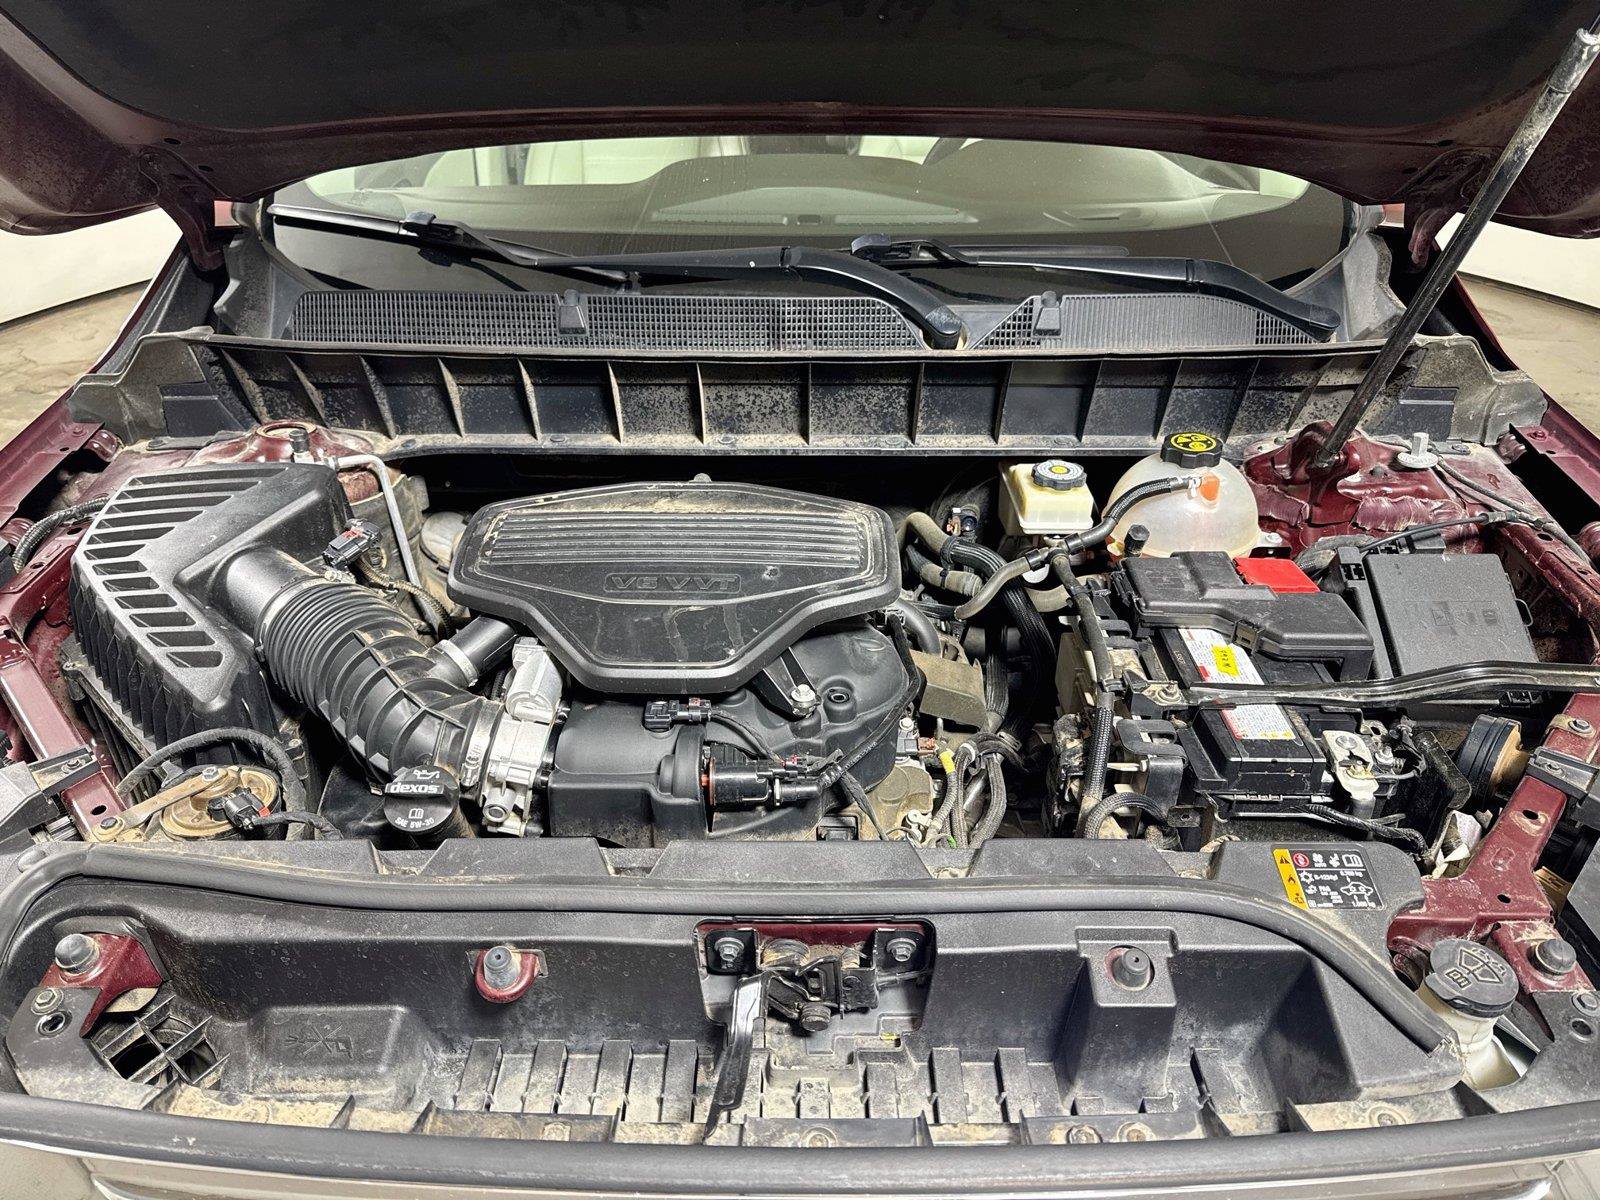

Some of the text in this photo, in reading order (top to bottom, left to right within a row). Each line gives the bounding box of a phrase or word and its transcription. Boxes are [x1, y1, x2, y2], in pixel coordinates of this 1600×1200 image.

[611, 576, 736, 591] V6 VVT
[390, 783, 440, 794] dexos
[395, 817, 434, 828] SAE 5W-30
